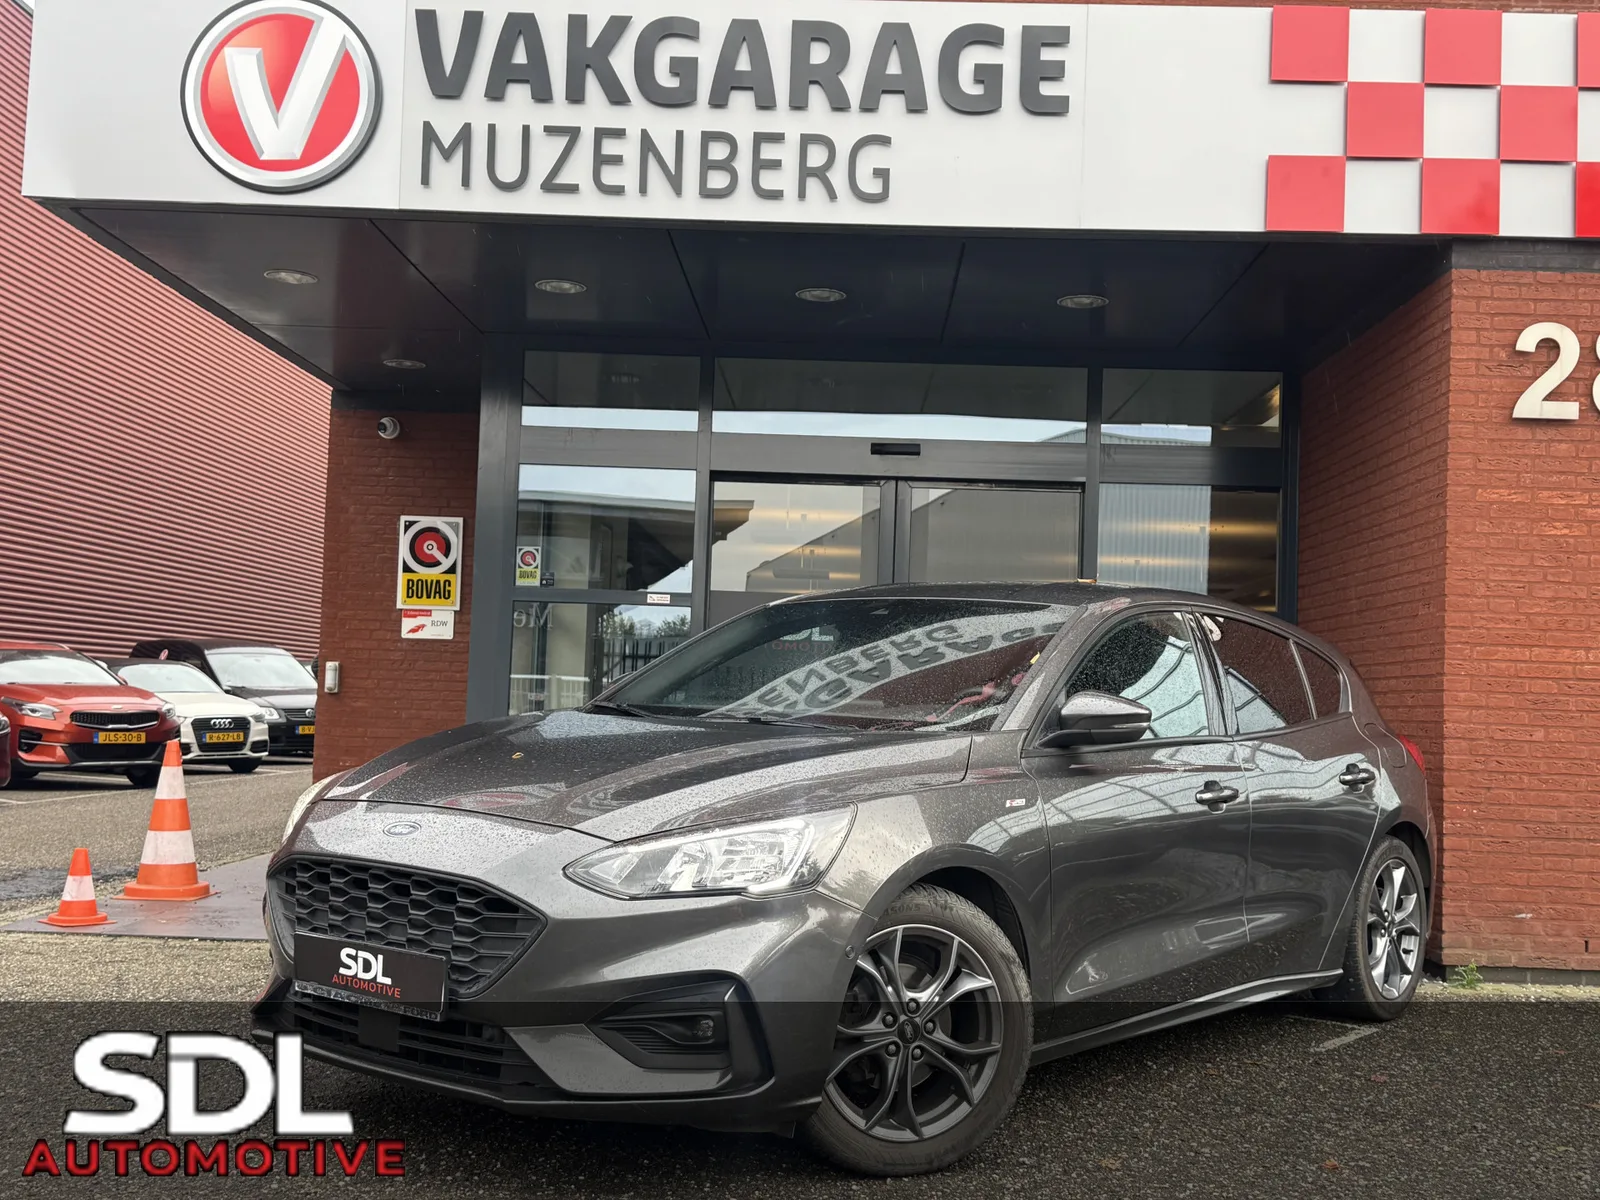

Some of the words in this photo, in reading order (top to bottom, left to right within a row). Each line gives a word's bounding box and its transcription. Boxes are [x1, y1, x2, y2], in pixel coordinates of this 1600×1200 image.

[414, 8, 1071, 115] VAKGARAGE
[420, 120, 893, 203] MUZENBERG
[1512, 321, 1600, 420] 2
[518, 569, 537, 579] BOVAG
[406, 578, 452, 600] BOVAG
[430, 619, 449, 627] RDW
[102, 733, 142, 742] JLS-30-B
[338, 946, 392, 985] SDL
[331, 973, 402, 999] AUTOMOTIVE
